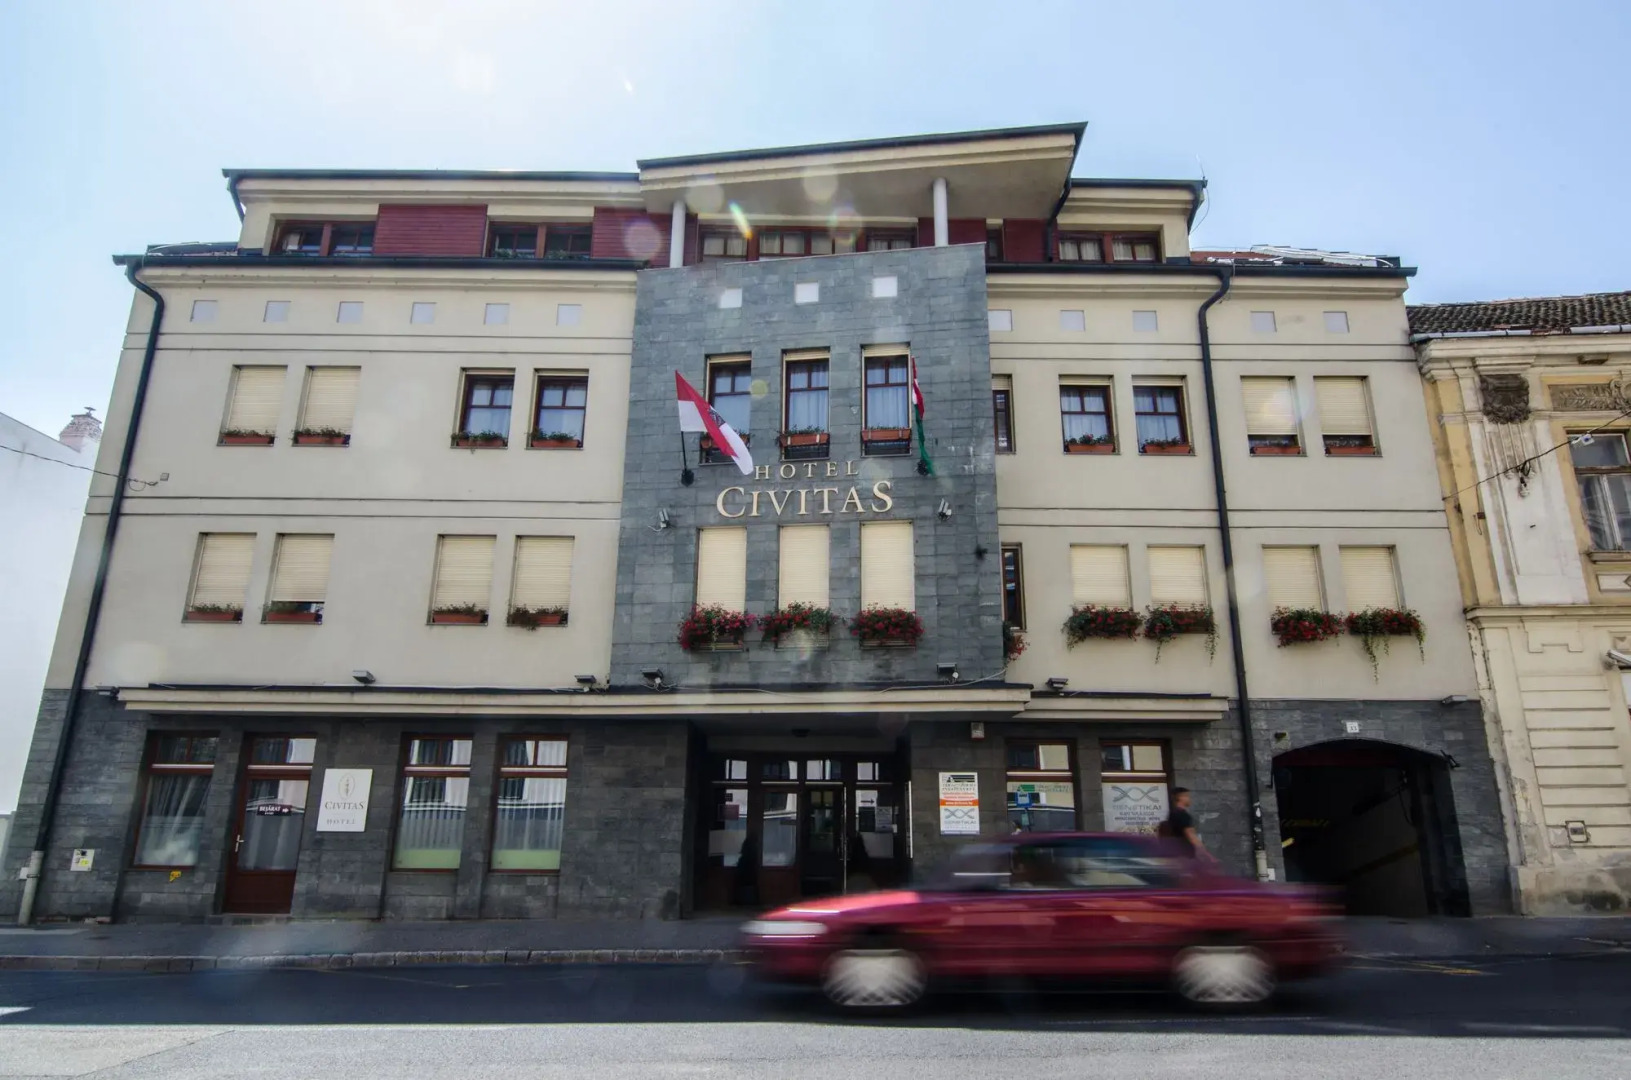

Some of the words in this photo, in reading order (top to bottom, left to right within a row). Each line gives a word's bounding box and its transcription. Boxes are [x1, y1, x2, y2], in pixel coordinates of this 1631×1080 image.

[754, 460, 859, 480] HOTEL
[716, 480, 894, 518] CIVITAS
[324, 801, 366, 810] CIVITAS
